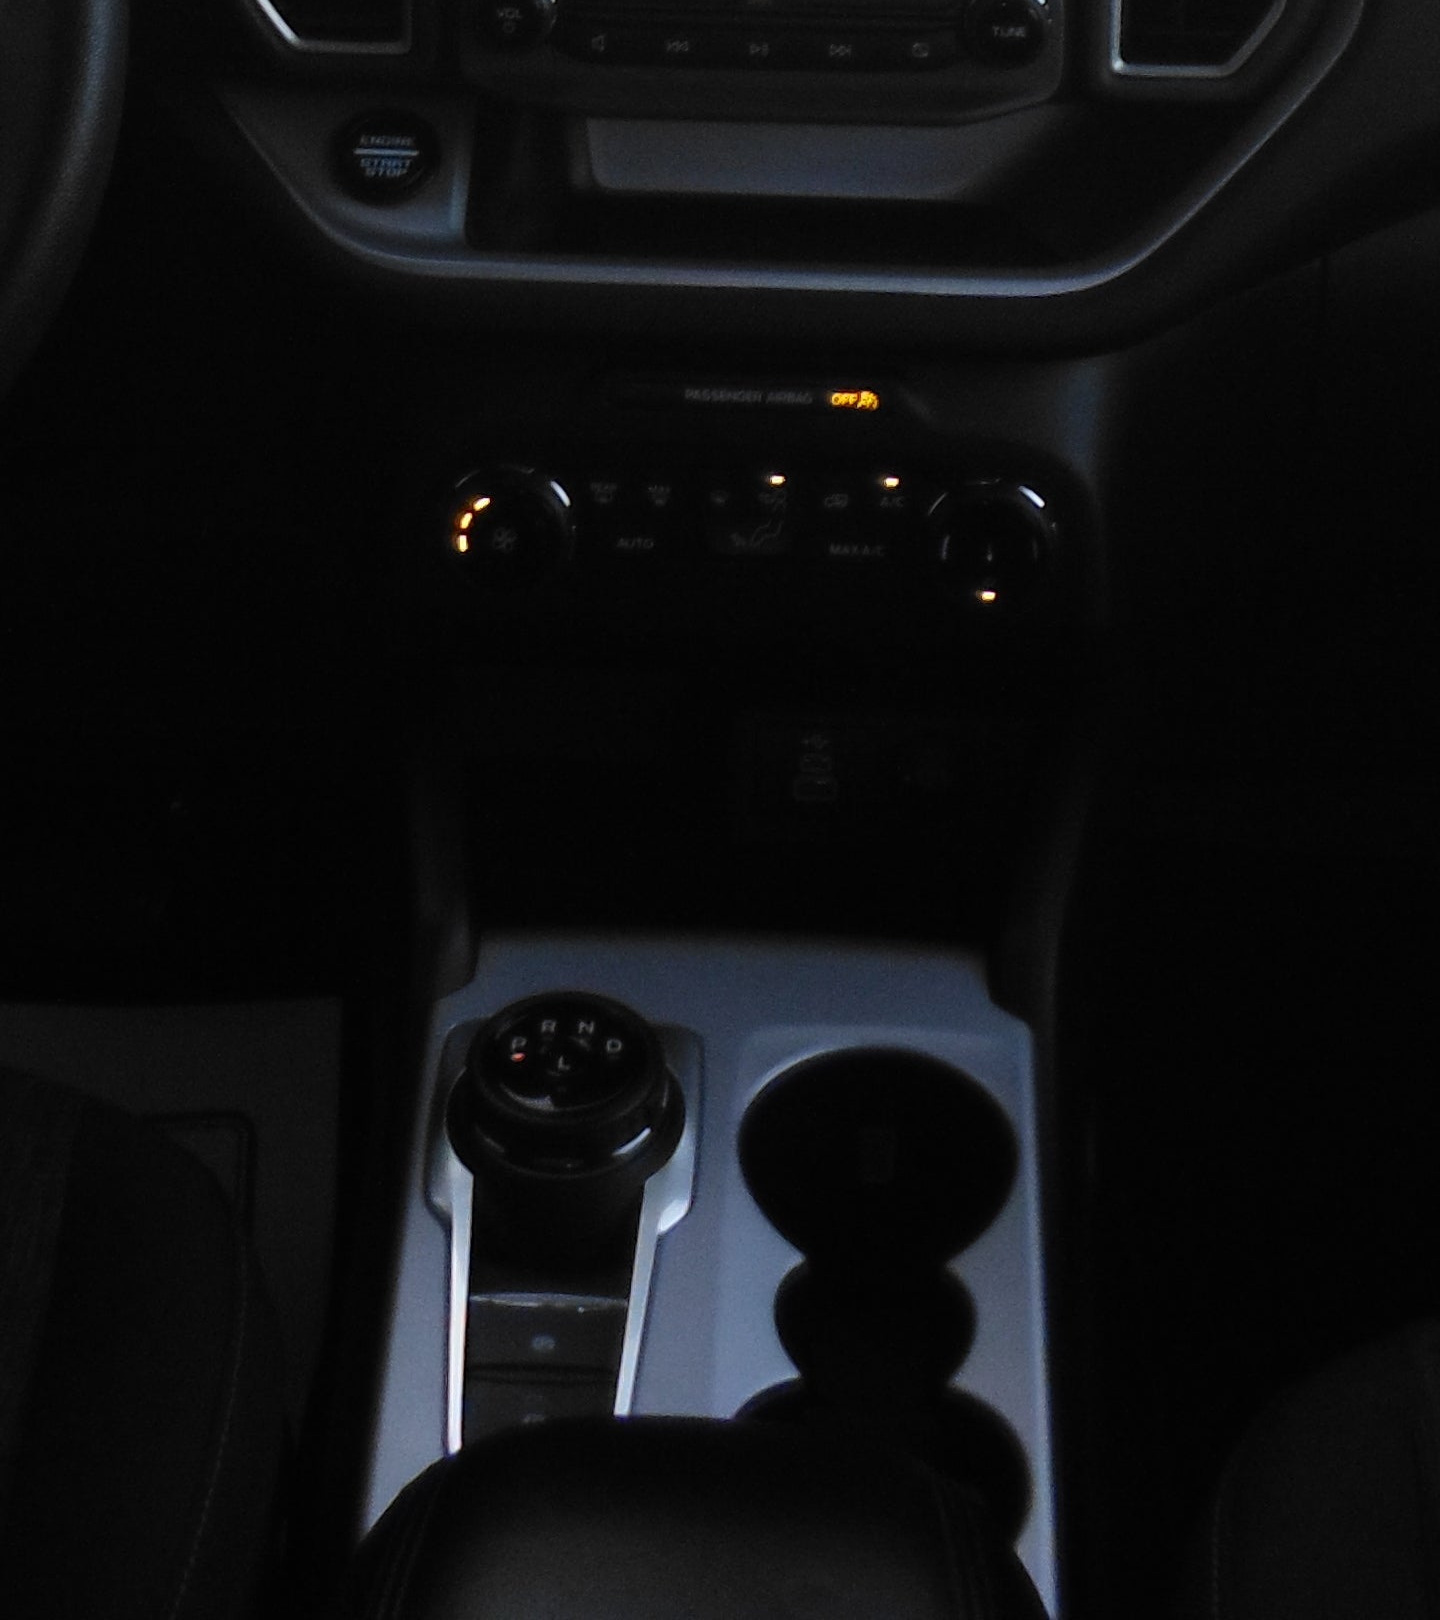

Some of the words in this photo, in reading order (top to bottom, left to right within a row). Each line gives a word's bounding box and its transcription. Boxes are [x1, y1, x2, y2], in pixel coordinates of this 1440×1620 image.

[360, 158, 412, 169] START
[365, 167, 408, 178] STOP
[683, 388, 763, 403] PASSENGER
[765, 389, 814, 405] AIRBAG
[831, 391, 859, 407] OFF
[879, 495, 905, 508] A/C
[616, 536, 656, 551] AUTO
[828, 543, 858, 556] MAX
[862, 544, 886, 558] A/C
[540, 1018, 557, 1034] R
[576, 1018, 596, 1035] N
[510, 1034, 528, 1052] P
[605, 1037, 624, 1054] D
[558, 1055, 571, 1071] L
